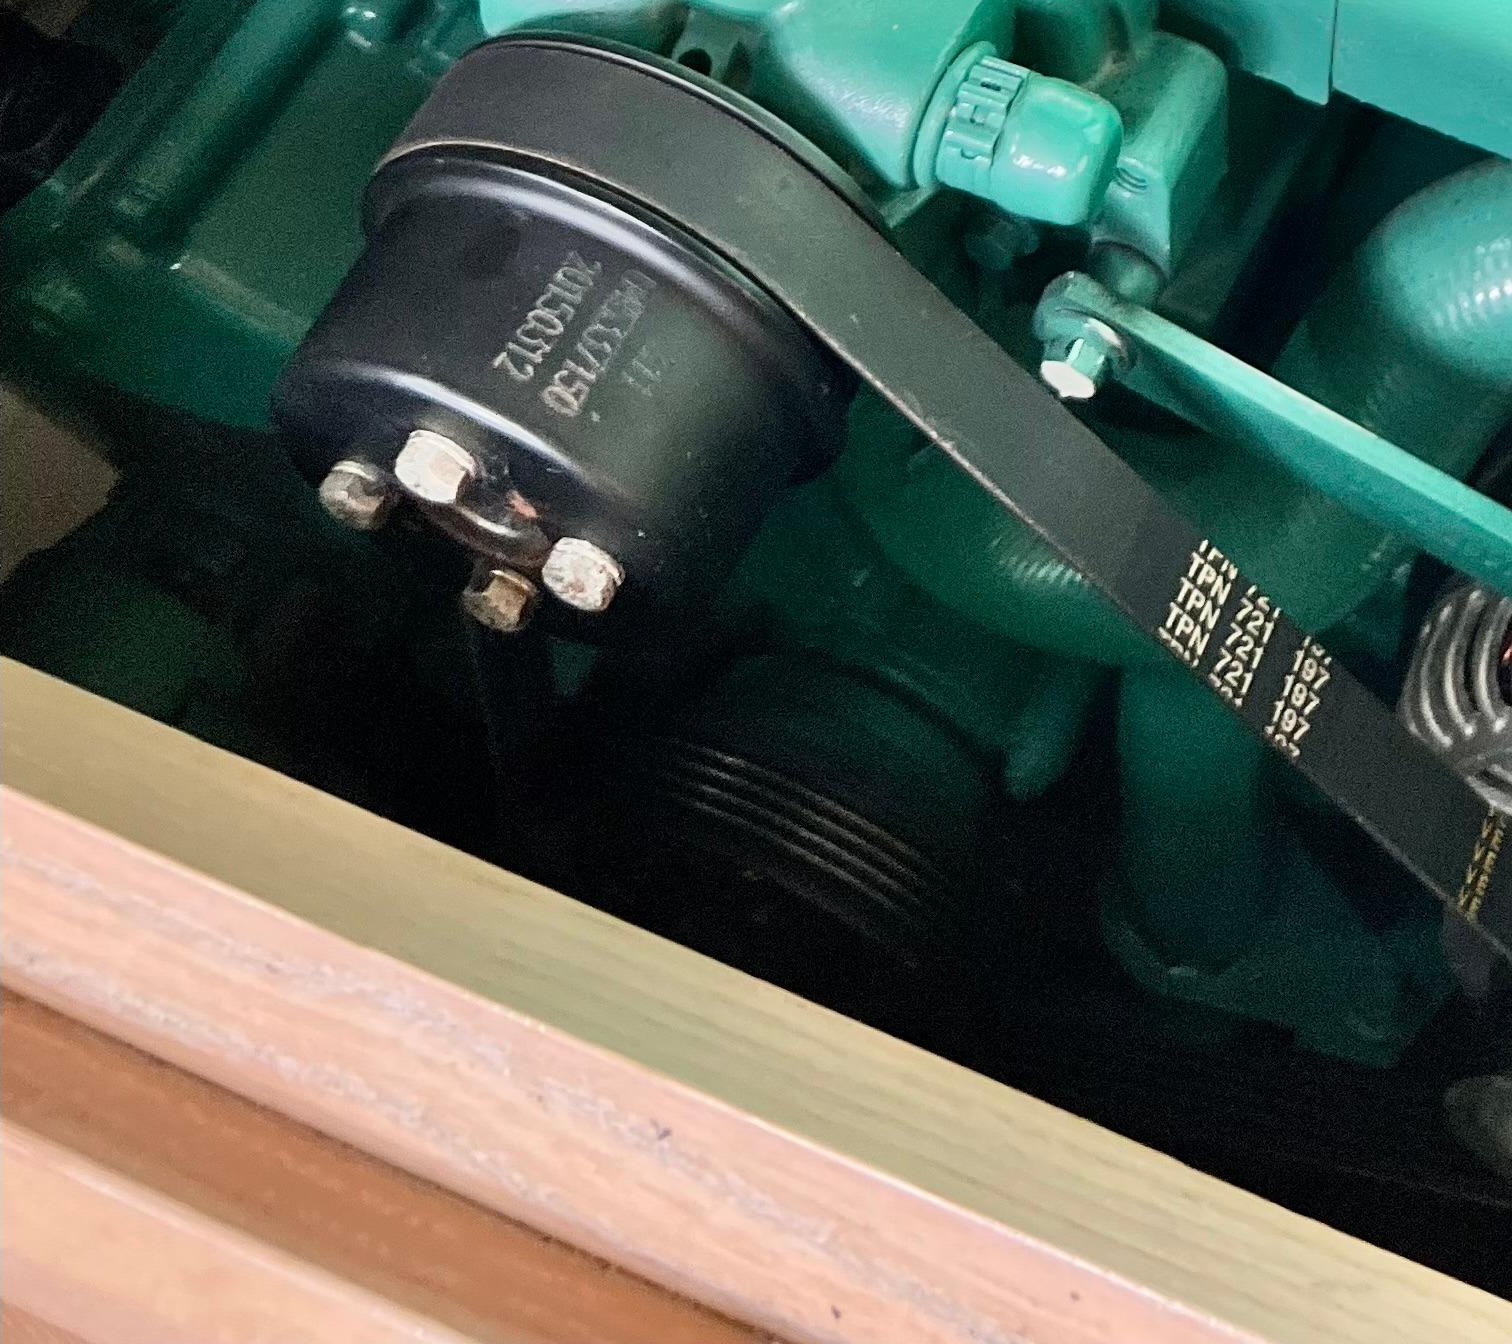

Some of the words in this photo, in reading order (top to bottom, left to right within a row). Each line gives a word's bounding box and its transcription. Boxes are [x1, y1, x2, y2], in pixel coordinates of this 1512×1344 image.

[1166, 601, 1210, 656] TPN
[1214, 647, 1253, 695] 721
[1272, 700, 1310, 741] 197
[1177, 577, 1220, 630] TPN
[1225, 622, 1263, 669] 721
[1283, 674, 1320, 716] 197
[1188, 551, 1232, 606] TPN
[1236, 598, 1274, 644] 721
[1293, 649, 1331, 690] 197
